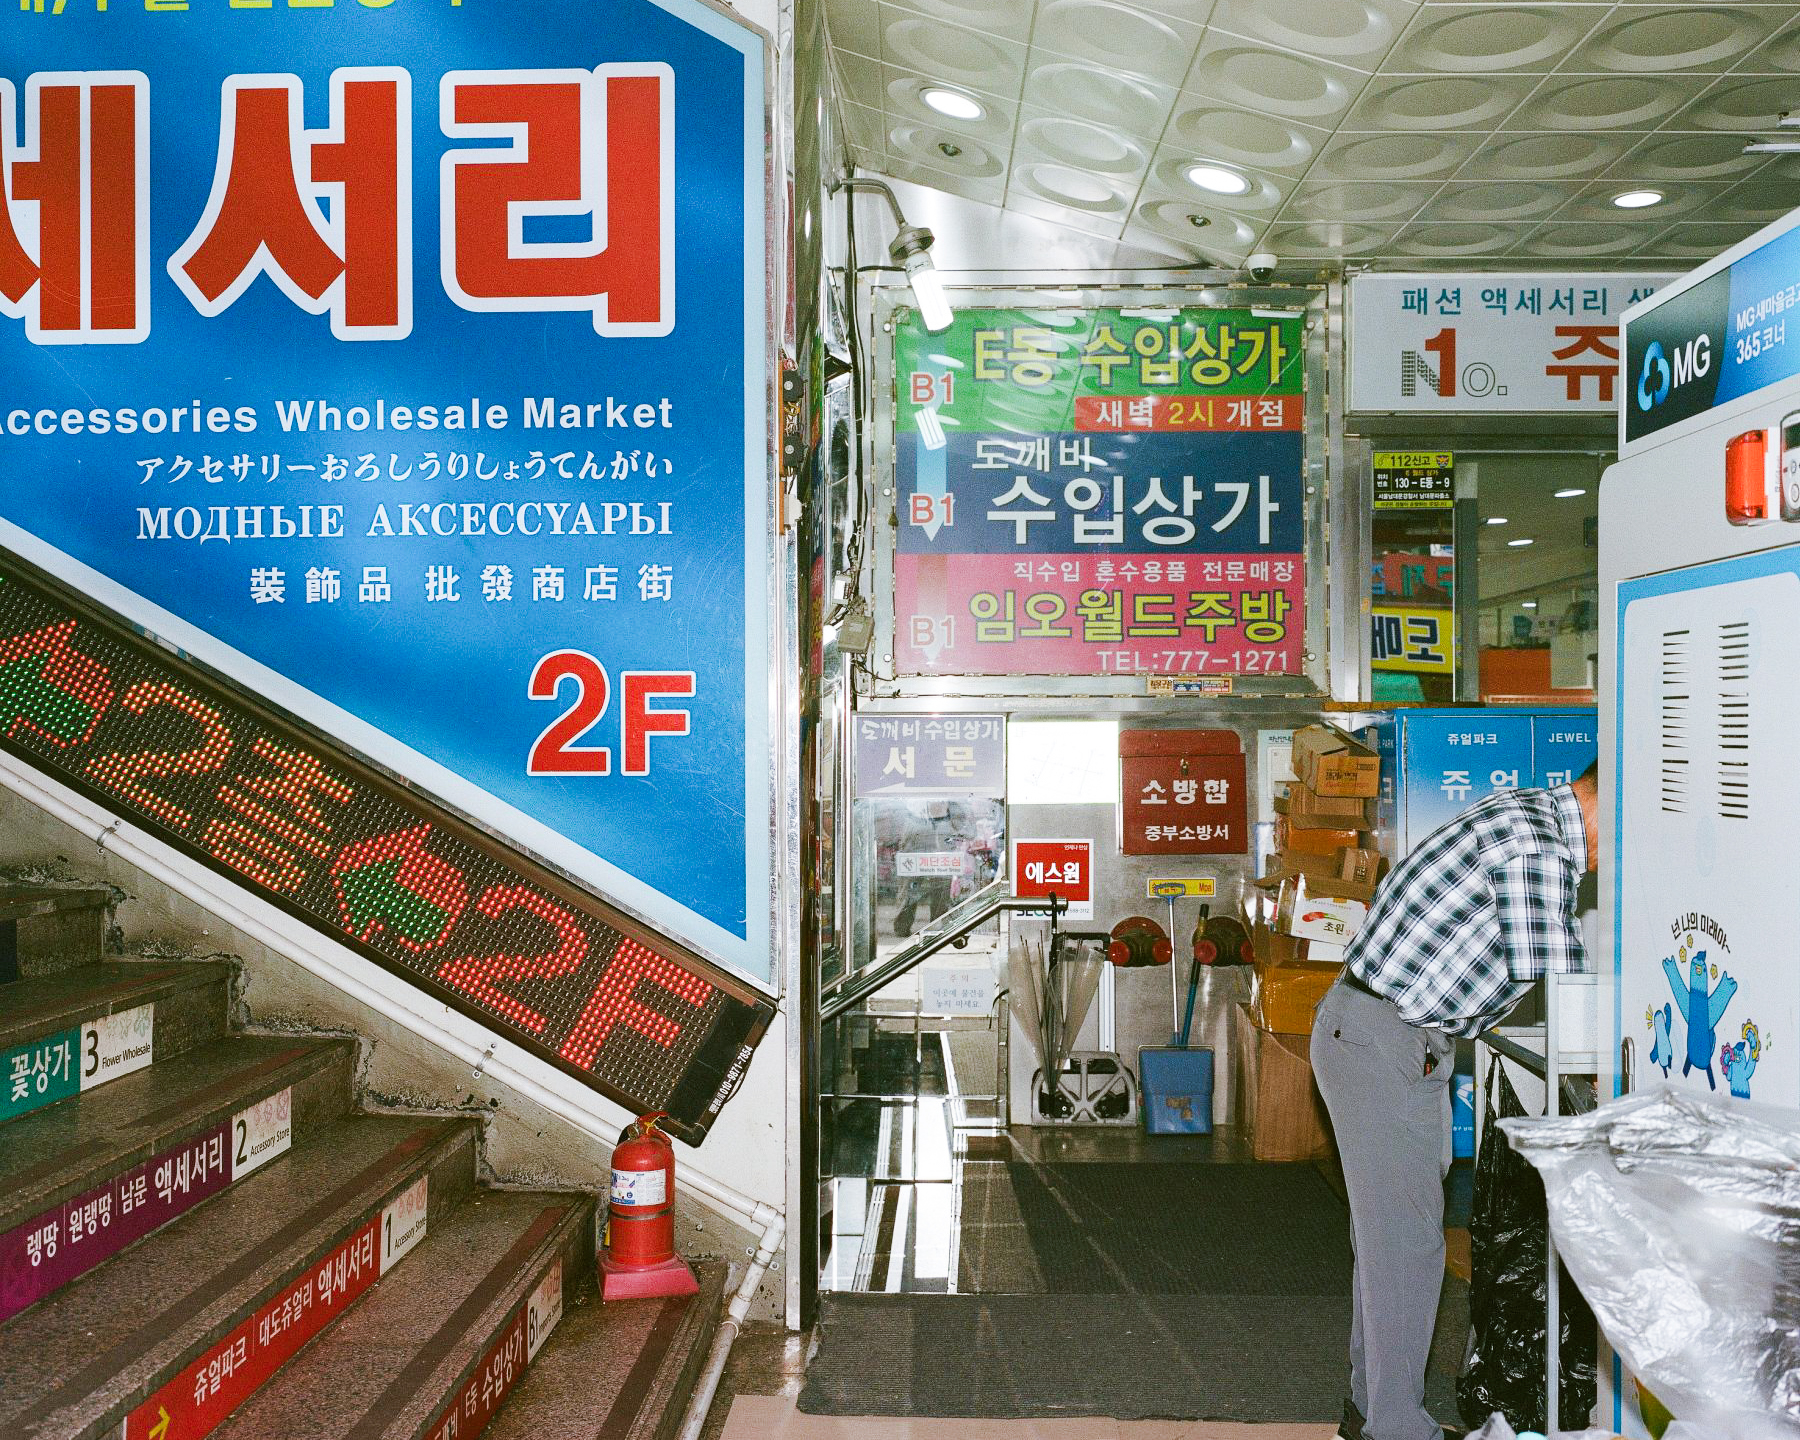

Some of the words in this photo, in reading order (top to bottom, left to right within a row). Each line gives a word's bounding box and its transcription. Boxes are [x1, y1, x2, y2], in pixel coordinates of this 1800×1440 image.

[1402, 287, 1461, 315] 패션
[1481, 287, 1607, 315] 액세서리
[974, 327, 1057, 385] E동
[1083, 325, 1288, 386] 수입상가
[1674, 334, 1710, 388] MG
[910, 371, 955, 404] B1
[0, 400, 257, 432] ccessories
[275, 398, 508, 432] Wholesale
[524, 397, 674, 430] Market
[1096, 400, 1154, 428] 새벽
[1168, 401, 1215, 427] 2시
[1226, 400, 1283, 427] 개점
[136, 452, 674, 484] アクセサリーおろしうりしょうてんがい
[972, 438, 1092, 473] 도깨비
[1395, 477, 1409, 488] 130
[910, 494, 955, 526] B1
[986, 475, 1281, 545] 수입상가
[1013, 561, 1081, 582] 직수입
[1095, 561, 1186, 582] 혼수용품
[1202, 561, 1294, 582] 전문매장
[910, 615, 955, 649] B1
[969, 589, 1291, 643] 임오월드주방
[1097, 651, 1289, 672] TEL:777-1271
[526, 649, 697, 777] 2F
[861, 720, 920, 742] 도깨비
[924, 720, 1000, 742] 수입상가
[1447, 733, 1498, 746] 쥬얼파크
[1549, 733, 1591, 743] JEWEL
[1141, 779, 1229, 804] 소방함
[1145, 824, 1229, 842] 중부소방서
[1025, 862, 1080, 884] 에스원
[1323, 921, 1345, 936] 초원
[1681, 912, 1698, 932] 나의
[85, 1029, 99, 1078] 3
[102, 1053, 122, 1069] Flower
[122, 1043, 151, 1061] Wholesale
[10, 1040, 71, 1103] 꽃상가
[235, 1119, 248, 1167] 2
[251, 1137, 276, 1157] Accessory
[276, 1127, 290, 1142] Store
[121, 1174, 148, 1215] 남문
[154, 1133, 223, 1204] 액세서리
[385, 1213, 392, 1258] 1
[394, 1229, 415, 1251] Accessory
[415, 1217, 427, 1234] Store
[194, 1336, 247, 1407] 쥬얼파크
[259, 1279, 312, 1347] 대도쥬얼리
[318, 1228, 374, 1306] 액세서리
[529, 1306, 539, 1350] B1
[465, 1382, 477, 1418] E동
[482, 1322, 524, 1410] 수입상가
